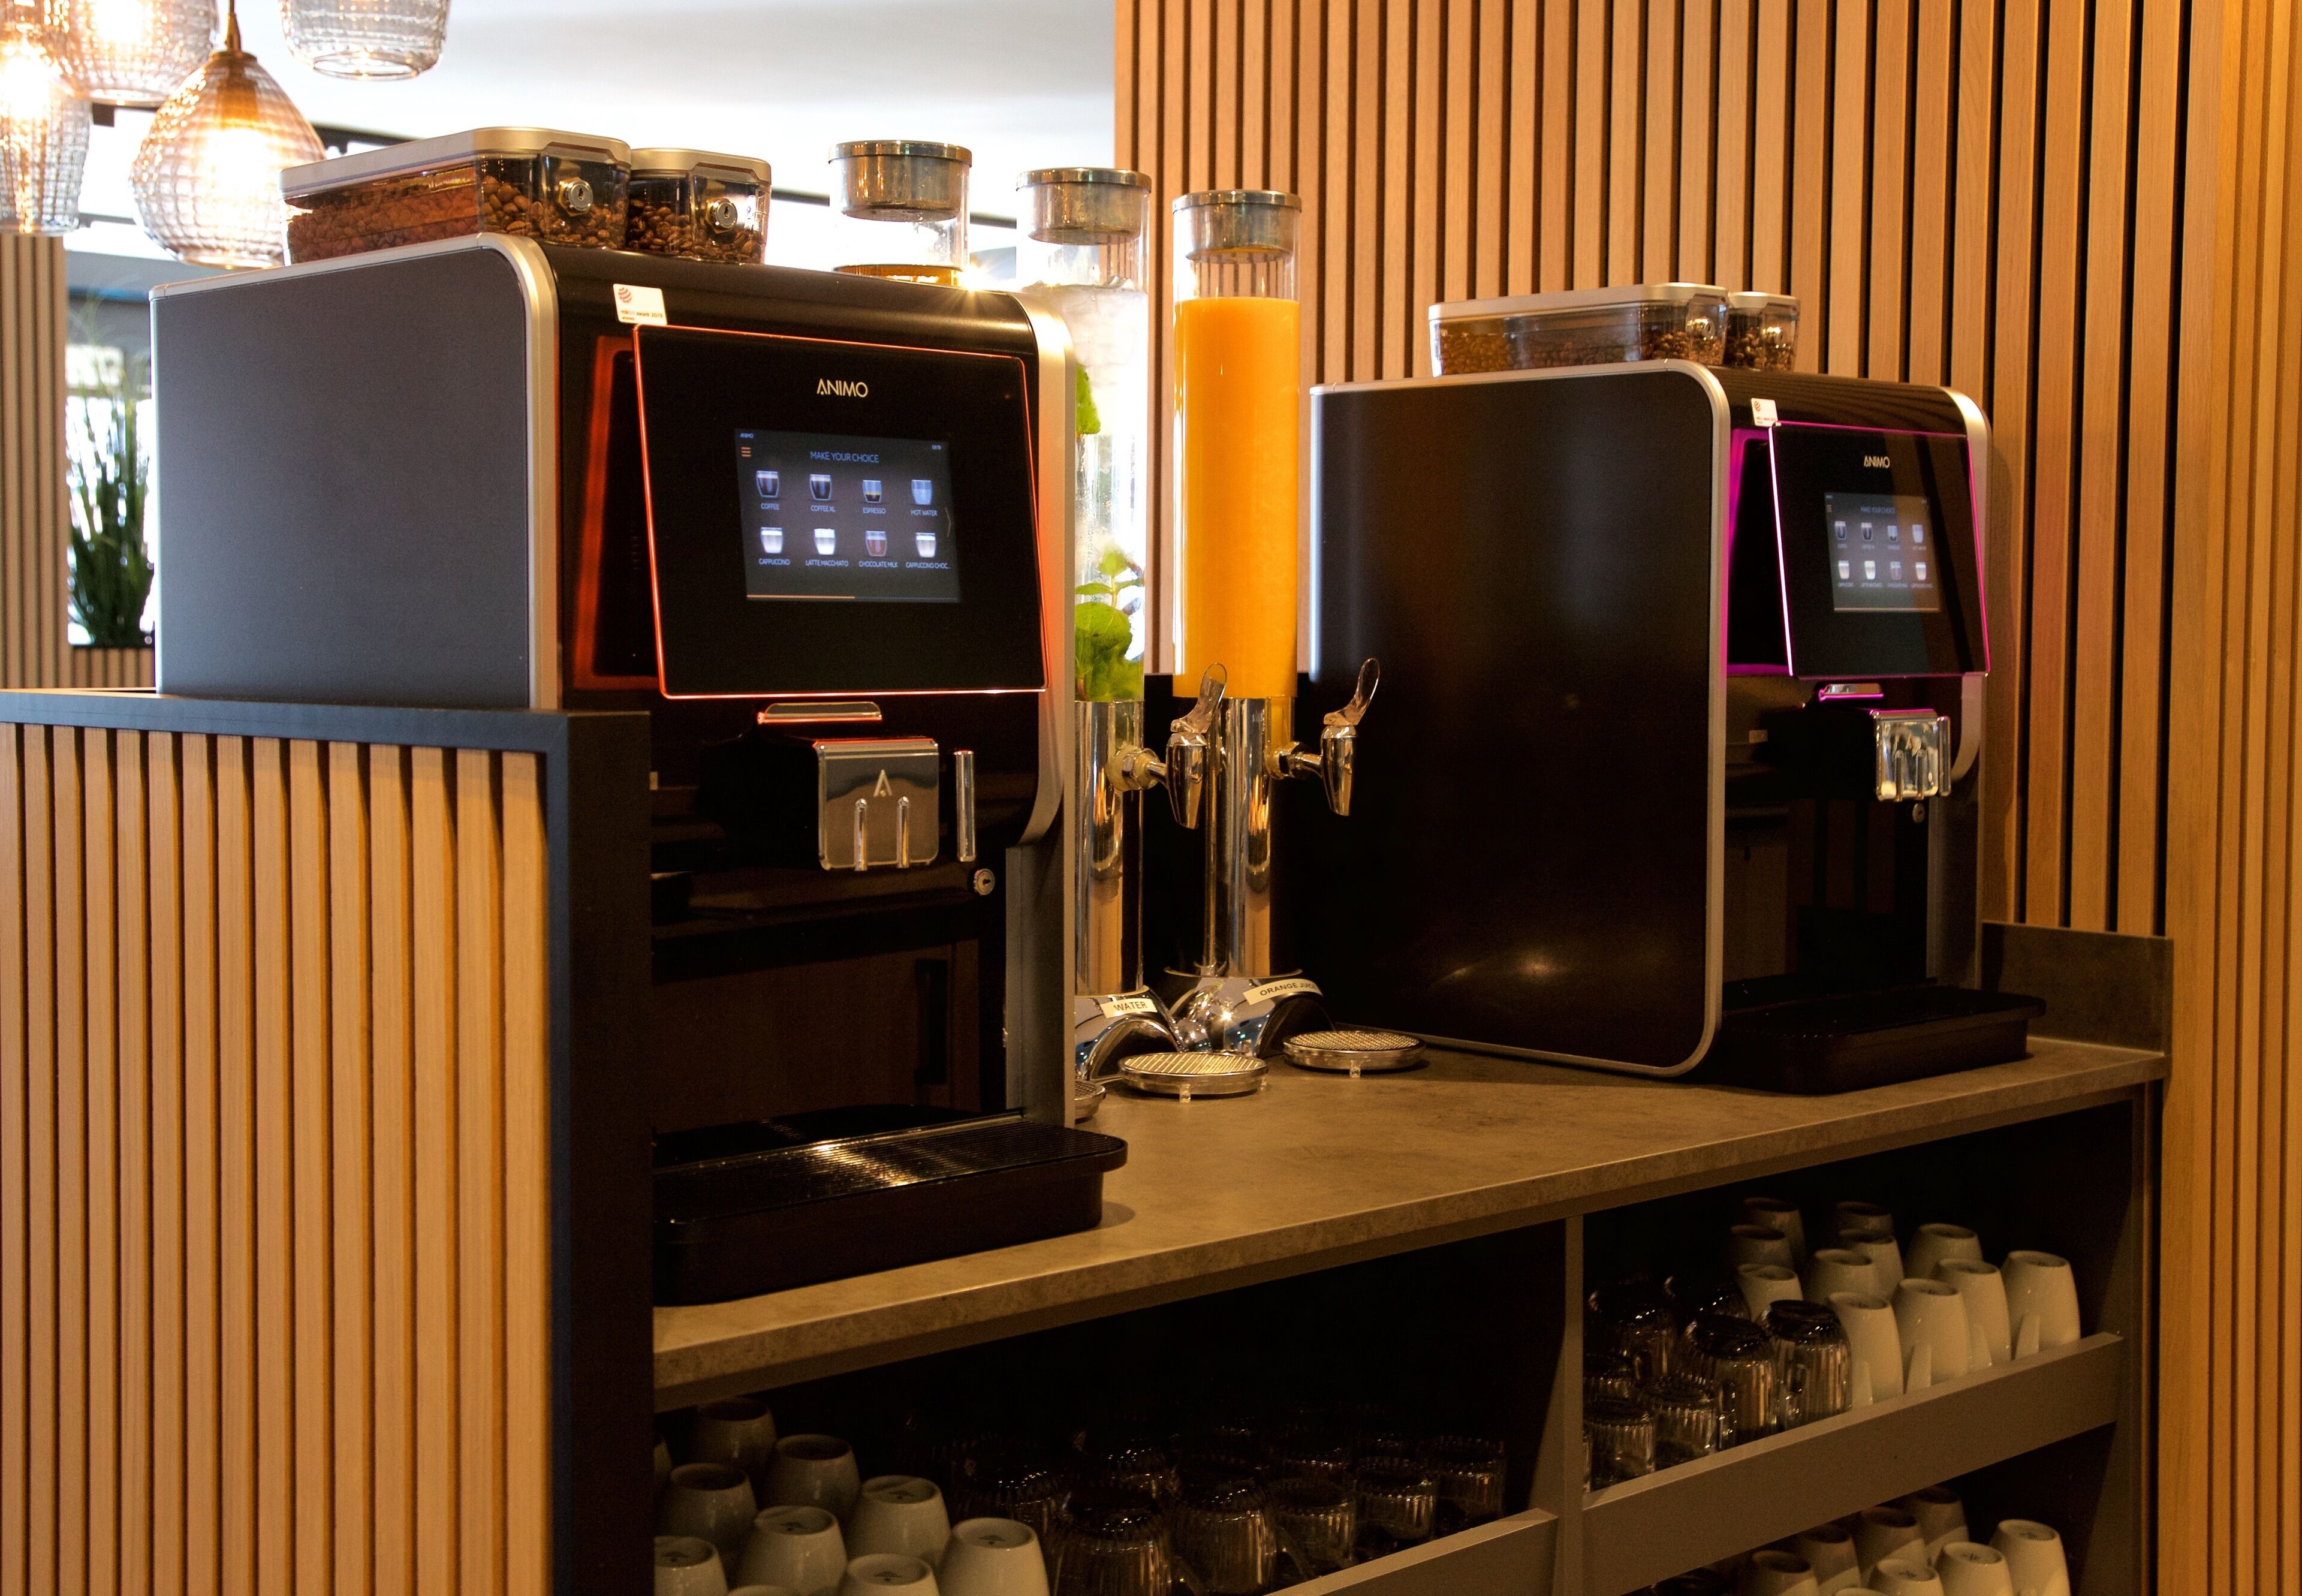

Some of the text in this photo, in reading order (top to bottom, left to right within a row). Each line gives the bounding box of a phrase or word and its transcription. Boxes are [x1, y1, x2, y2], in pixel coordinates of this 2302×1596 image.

[816, 378, 869, 398] ANIMO
[810, 451, 879, 463] MAKE YOUR CHOICE
[1864, 455, 1890, 468] ANIMO
[1260, 983, 1298, 996] ORANGE
[1113, 1001, 1148, 1011] WATER
